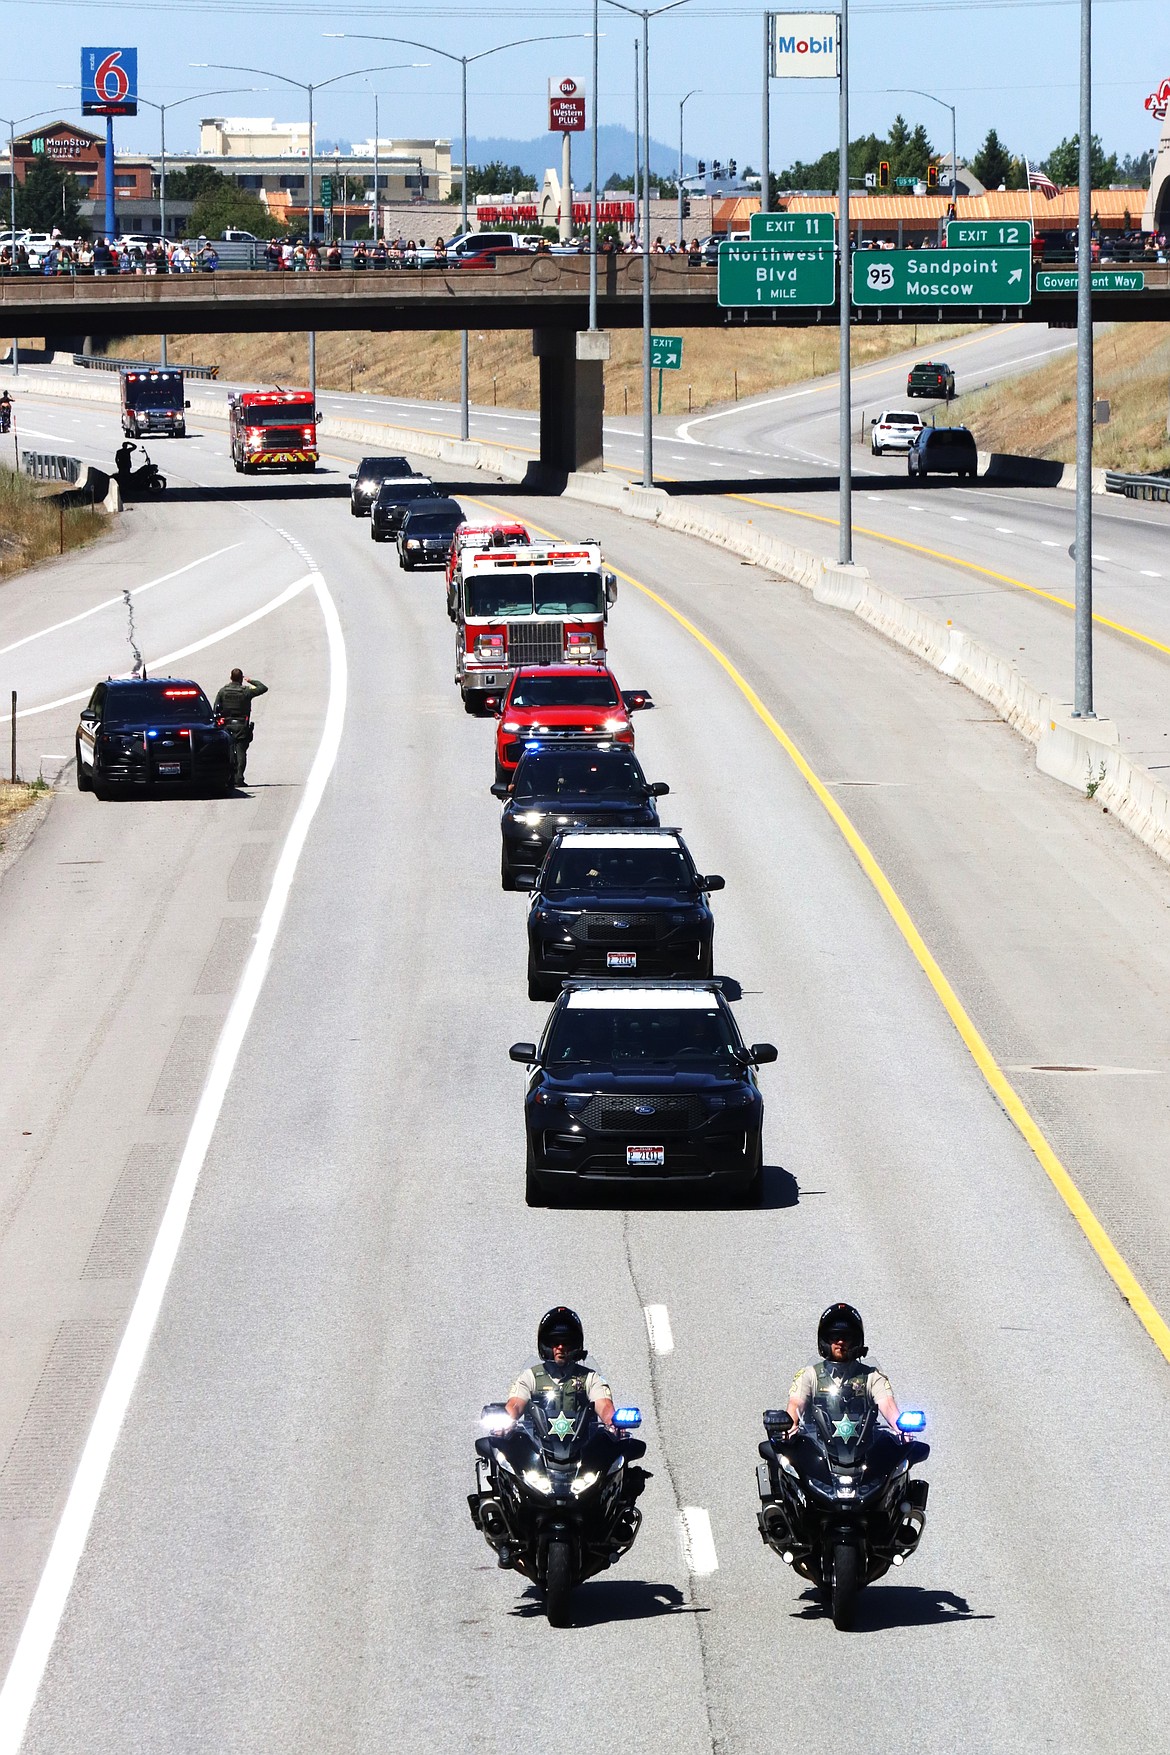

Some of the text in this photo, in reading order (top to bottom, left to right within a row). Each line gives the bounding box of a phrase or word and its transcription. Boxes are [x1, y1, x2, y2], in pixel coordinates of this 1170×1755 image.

[779, 36, 833, 53] Mobil
[94, 51, 129, 102] 6
[553, 109, 583, 117] Western
[46, 138, 91, 147] MainStay
[766, 219, 819, 234] EXIT 11
[959, 228, 1019, 243] EXIT 12
[728, 247, 824, 261] Northwest
[756, 267, 797, 281] Blvd
[907, 259, 998, 276] Sandpoint
[870, 269, 891, 284] 95
[1043, 275, 1137, 288] Goverent Way
[756, 288, 797, 301] 1 MILE
[906, 281, 974, 296] Moscow
[653, 338, 674, 348] EXIT
[652, 353, 662, 364] 2
